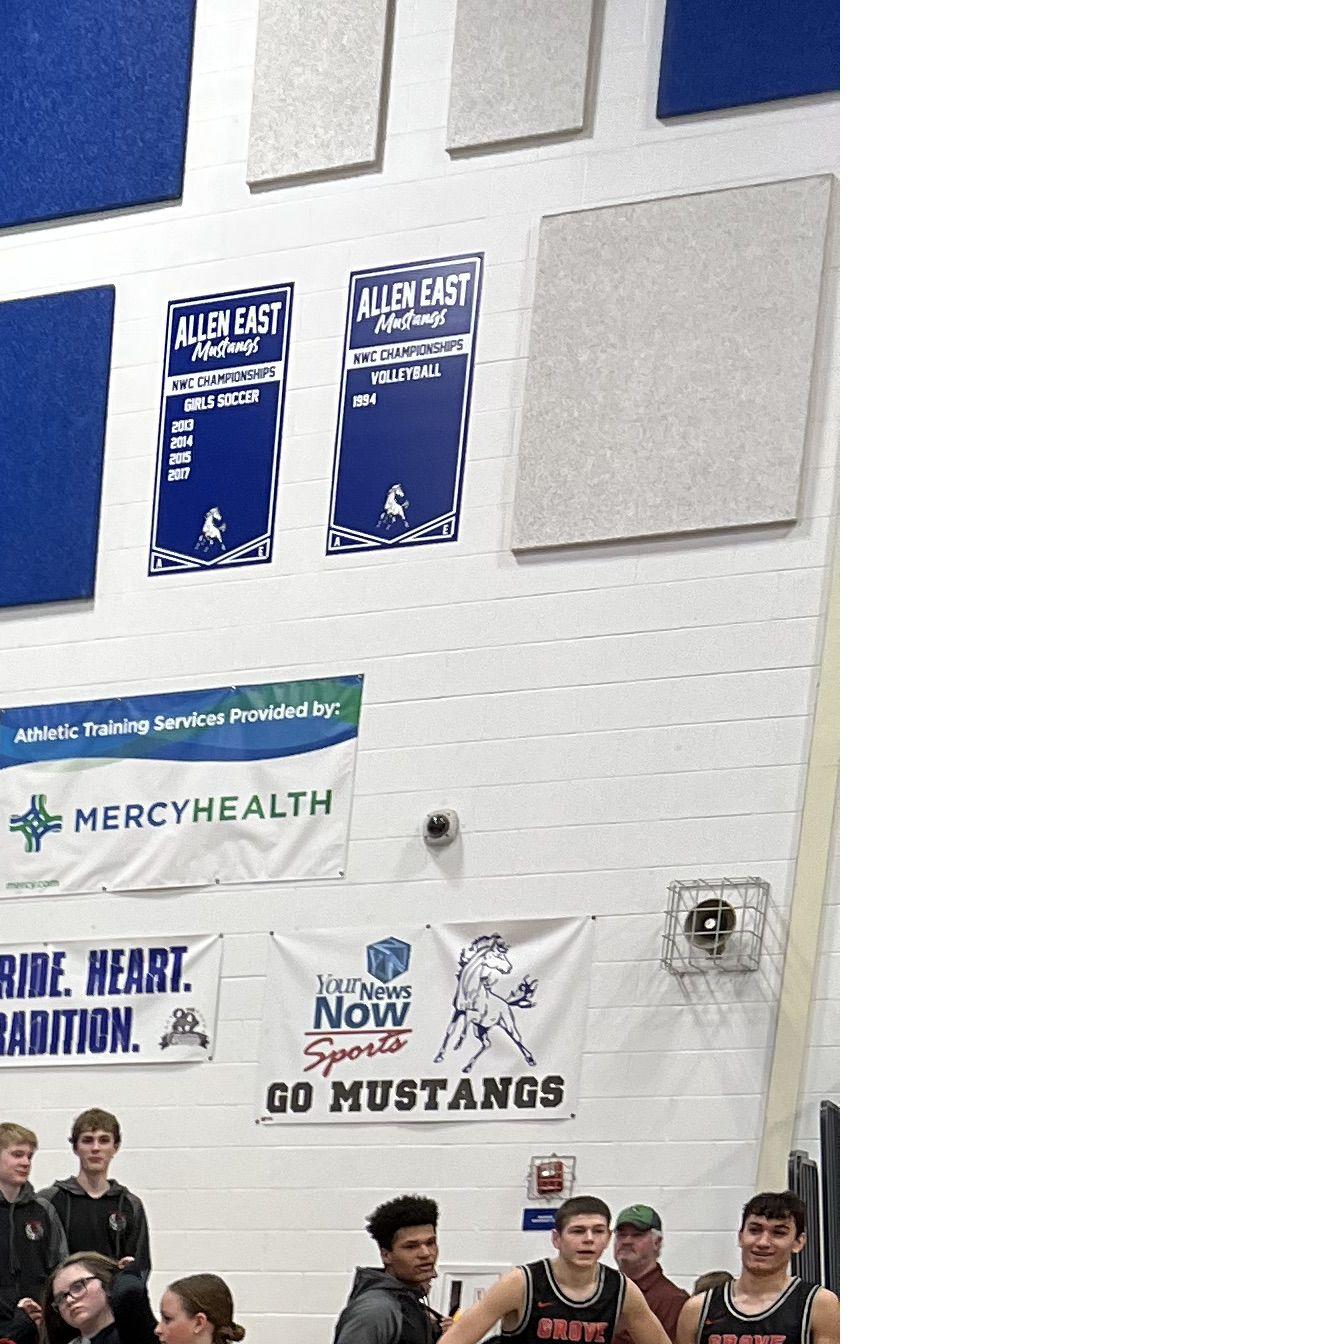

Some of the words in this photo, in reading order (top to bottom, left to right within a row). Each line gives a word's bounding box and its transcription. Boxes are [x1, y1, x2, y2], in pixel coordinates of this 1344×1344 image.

[356, 280, 416, 322] ALLEN
[420, 272, 471, 307] EAST
[174, 309, 231, 350] ALLEN
[234, 301, 282, 336] EAST
[374, 308, 447, 335] Mustangs
[191, 336, 261, 362] Mustangs
[353, 350, 378, 365] NWC
[380, 338, 464, 361] CHAMPIONSHIPS
[172, 377, 195, 392] NWC
[197, 365, 276, 388] CHAMPIONSHIPS
[371, 363, 442, 386] VOLLEYBALL
[184, 394, 215, 413] GIRLS
[217, 388, 260, 408] SOCCER
[170, 434, 194, 450] 2014
[168, 451, 192, 466] 2015
[167, 466, 191, 482] 2017
[14, 723, 79, 744] Athletic
[82, 718, 150, 738] Training
[153, 712, 226, 733] Services
[229, 702, 310, 724] Provided
[312, 700, 341, 720] by:
[74, 788, 333, 833] MERCYHEALTH
[86, 945, 193, 997] HEART.
[315, 974, 361, 996] Your
[360, 981, 412, 1001] News
[313, 994, 411, 1030] Now
[303, 1033, 409, 1078] Sports
[266, 1081, 313, 1114] GO
[329, 1075, 565, 1113] MUSTANGS
[537, 1317, 609, 1343] GROVE
